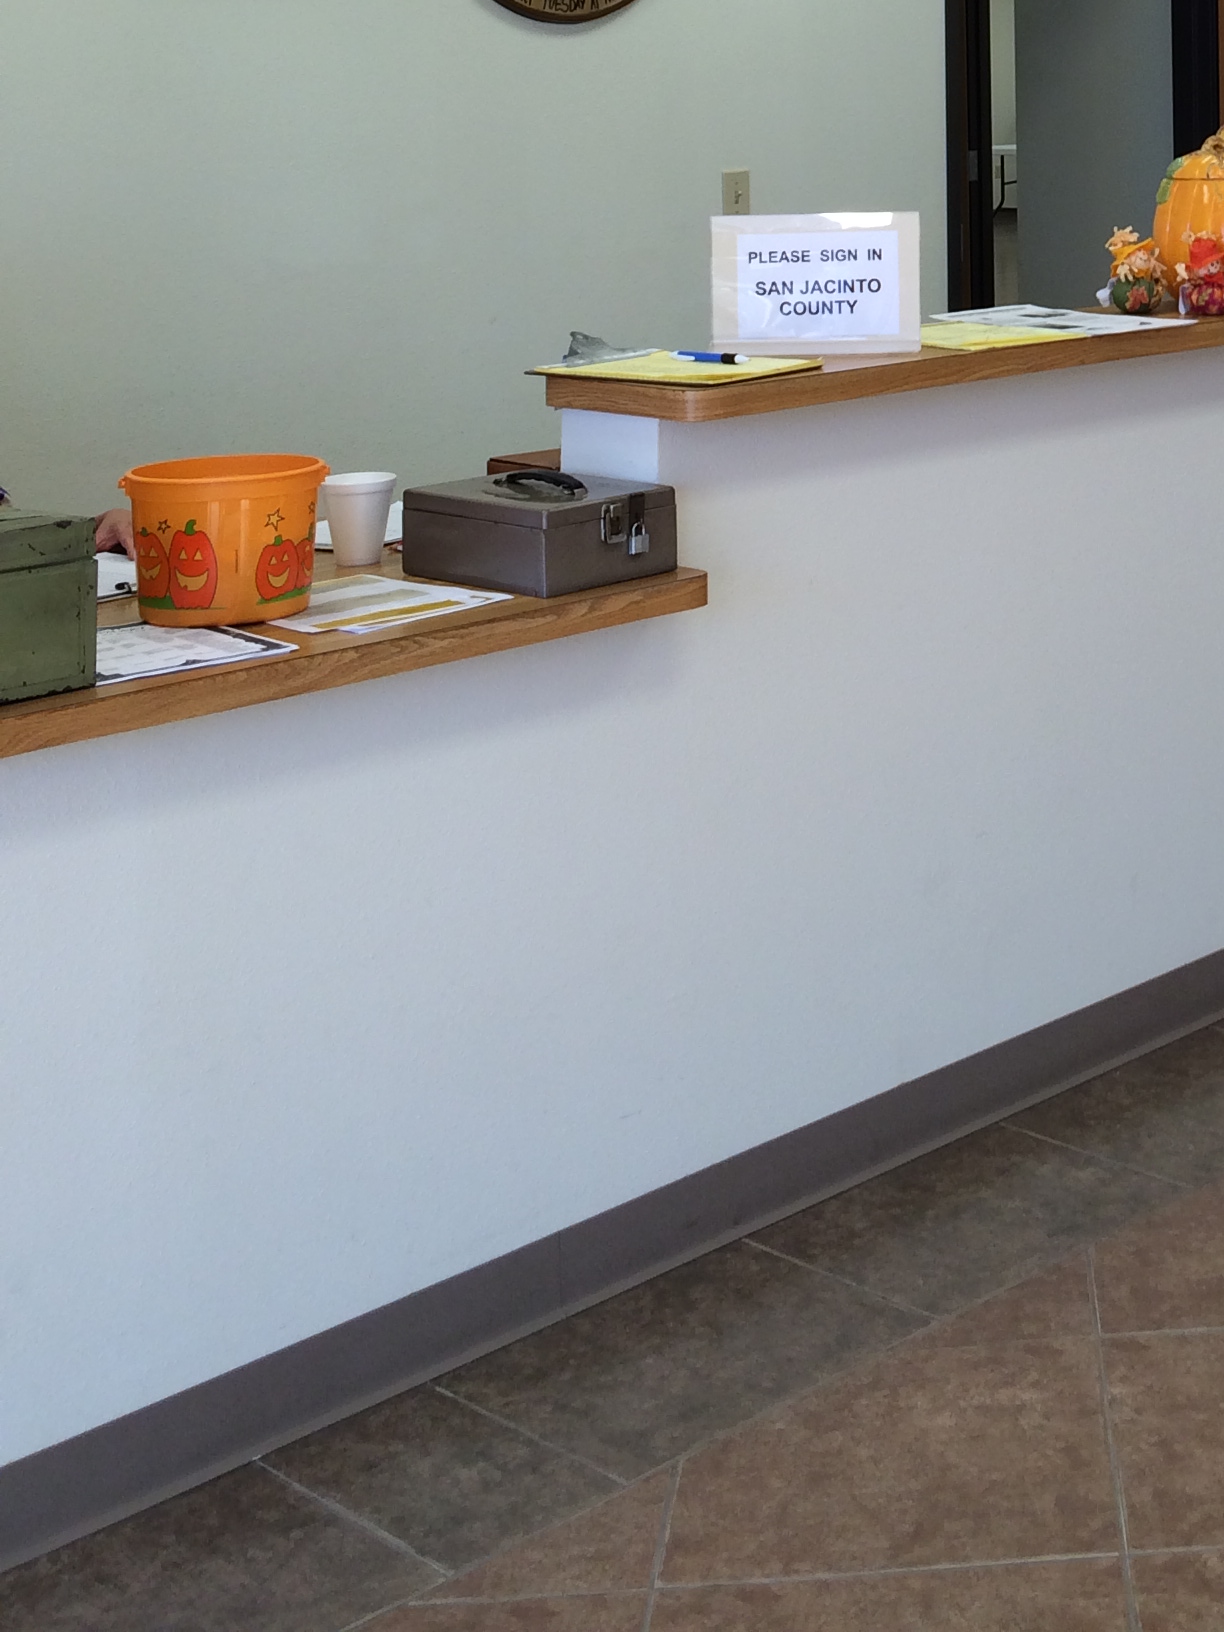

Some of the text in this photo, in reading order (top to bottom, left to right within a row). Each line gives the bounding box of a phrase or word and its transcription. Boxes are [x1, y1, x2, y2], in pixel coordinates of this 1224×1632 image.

[748, 248, 882, 264] PLEASE SIGN IN
[755, 278, 882, 296] SAN JACINTO
[779, 300, 858, 316] COUNTY
